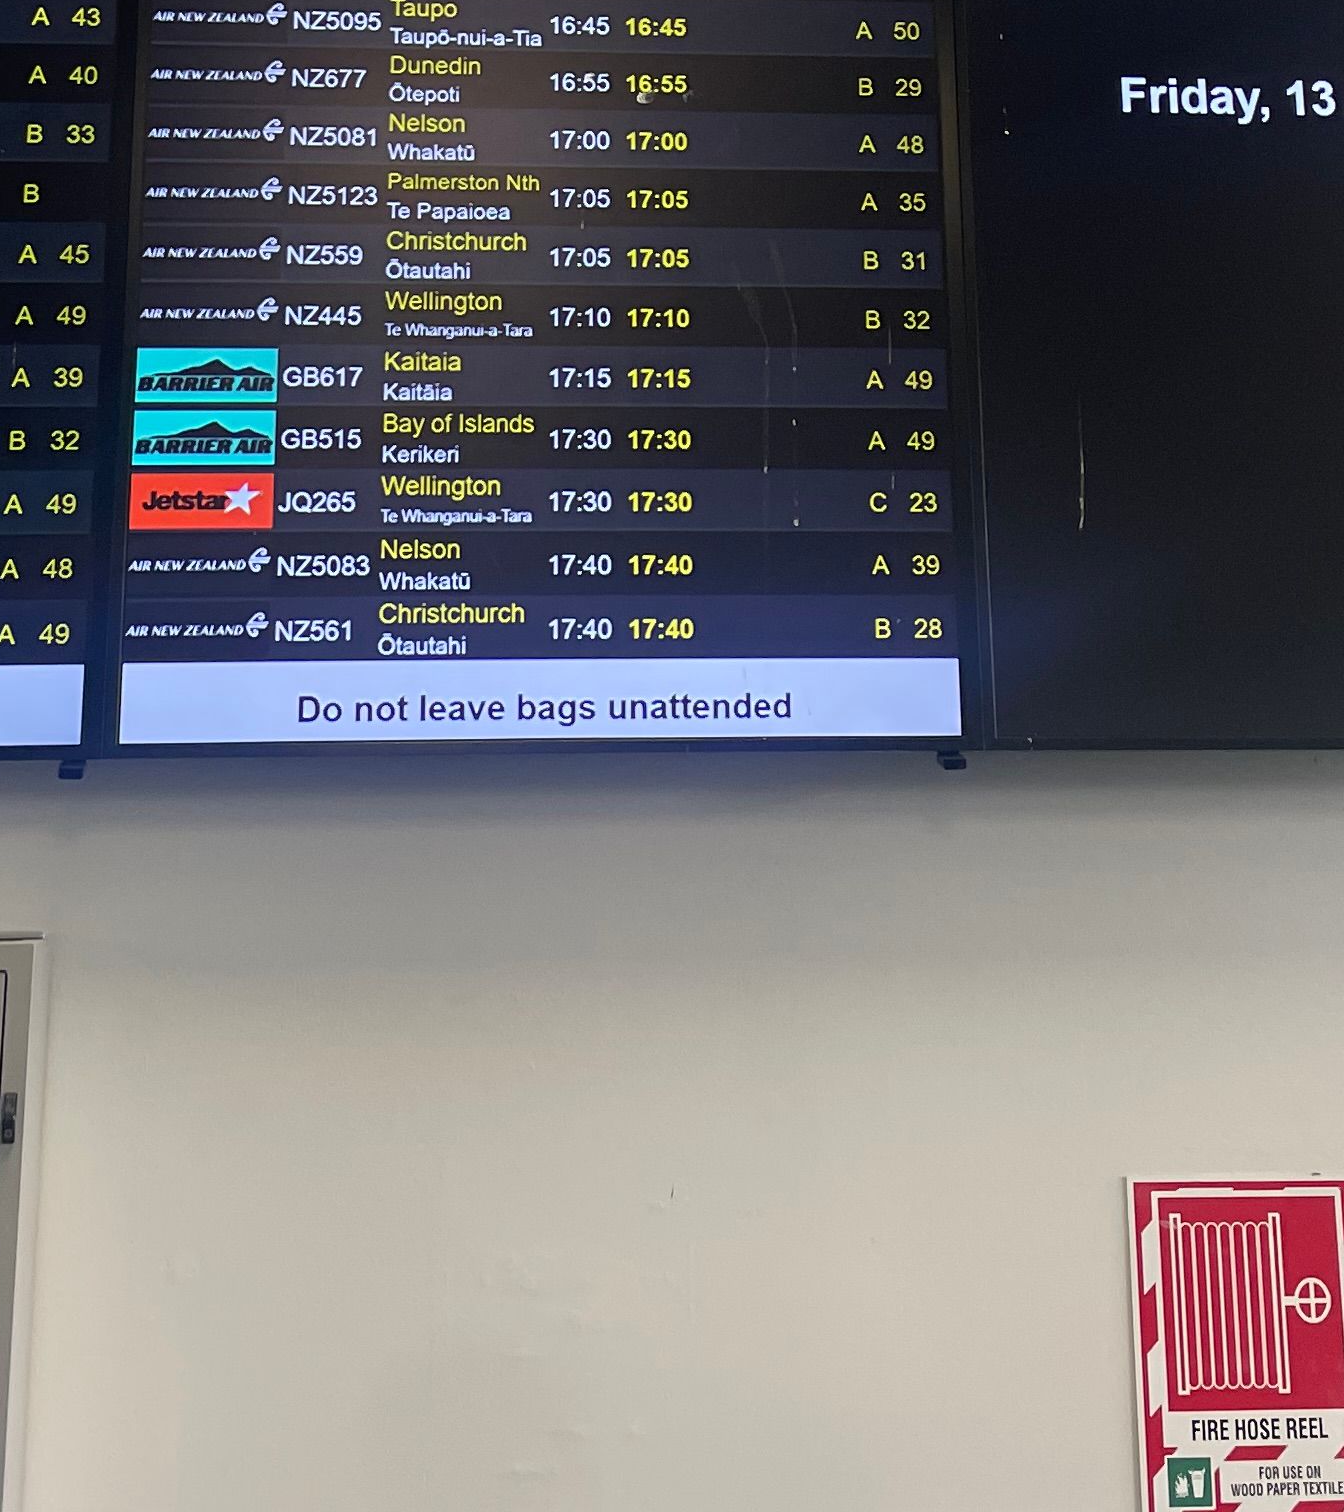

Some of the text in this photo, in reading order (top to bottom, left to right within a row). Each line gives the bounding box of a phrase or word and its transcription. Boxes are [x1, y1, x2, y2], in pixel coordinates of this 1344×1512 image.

[293, 11, 381, 31] NZ5095
[550, 16, 610, 35] 16:45
[625, 17, 686, 36] 16:45
[856, 21, 872, 39] A
[894, 22, 919, 40] 50
[390, 27, 542, 48] Taupō-nui-a-Tia
[1121, 77, 1269, 124] Friday,
[1287, 80, 1335, 116] 13
[23, 184, 39, 203] B
[137, 351, 932, 392] BARRIER AIR GB617 Kaitaia 17:15 17:15 A 49
[383, 383, 452, 401] Kaitāia
[3, 494, 22, 514] A
[46, 494, 76, 514] 49
[277, 539, 939, 577] NZ5083 Nelson 17:40 17:40 A 39
[379, 571, 470, 590] Whakatū
[299, 693, 791, 726] Do not leave bags unattended
[1192, 1418, 1328, 1440] FIRE HOSE REEL
[1259, 1466, 1321, 1479] FOR USE ON
[1231, 1483, 1263, 1496] WOOD
[1267, 1483, 1300, 1496] PAPER
